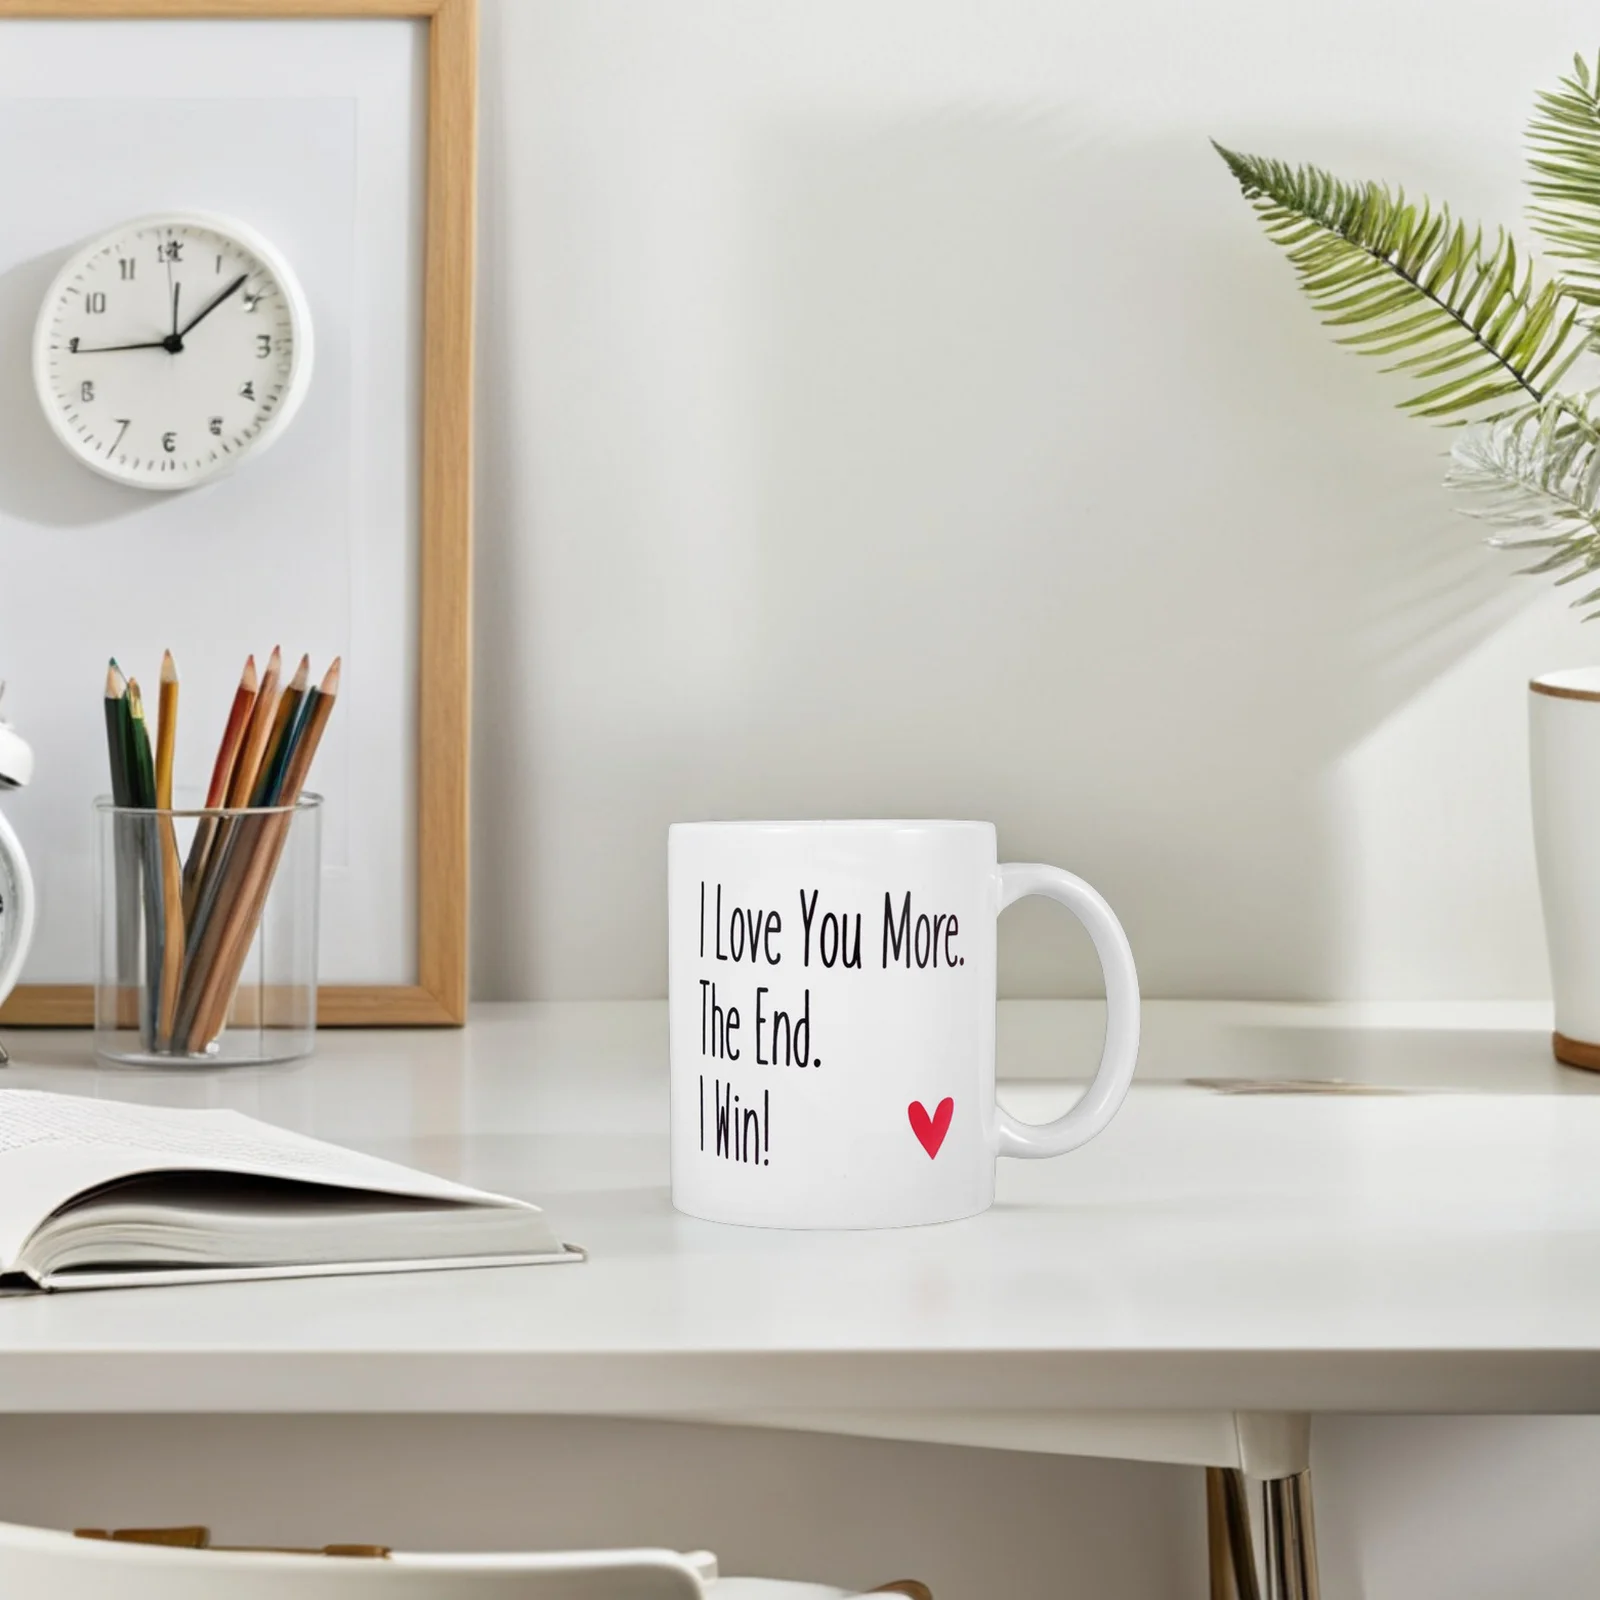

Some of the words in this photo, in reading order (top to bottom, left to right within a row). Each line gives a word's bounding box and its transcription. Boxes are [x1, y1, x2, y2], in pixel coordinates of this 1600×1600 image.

[85, 292, 107, 315] 10
[118, 257, 136, 280] 11
[699, 880, 706, 959] I
[715, 882, 783, 967] Love
[798, 887, 863, 971] You
[881, 889, 966, 970] More.
[698, 978, 742, 1062] The
[754, 985, 823, 1069] End.
[699, 1073, 705, 1153] I
[714, 1078, 770, 1168] Win!
